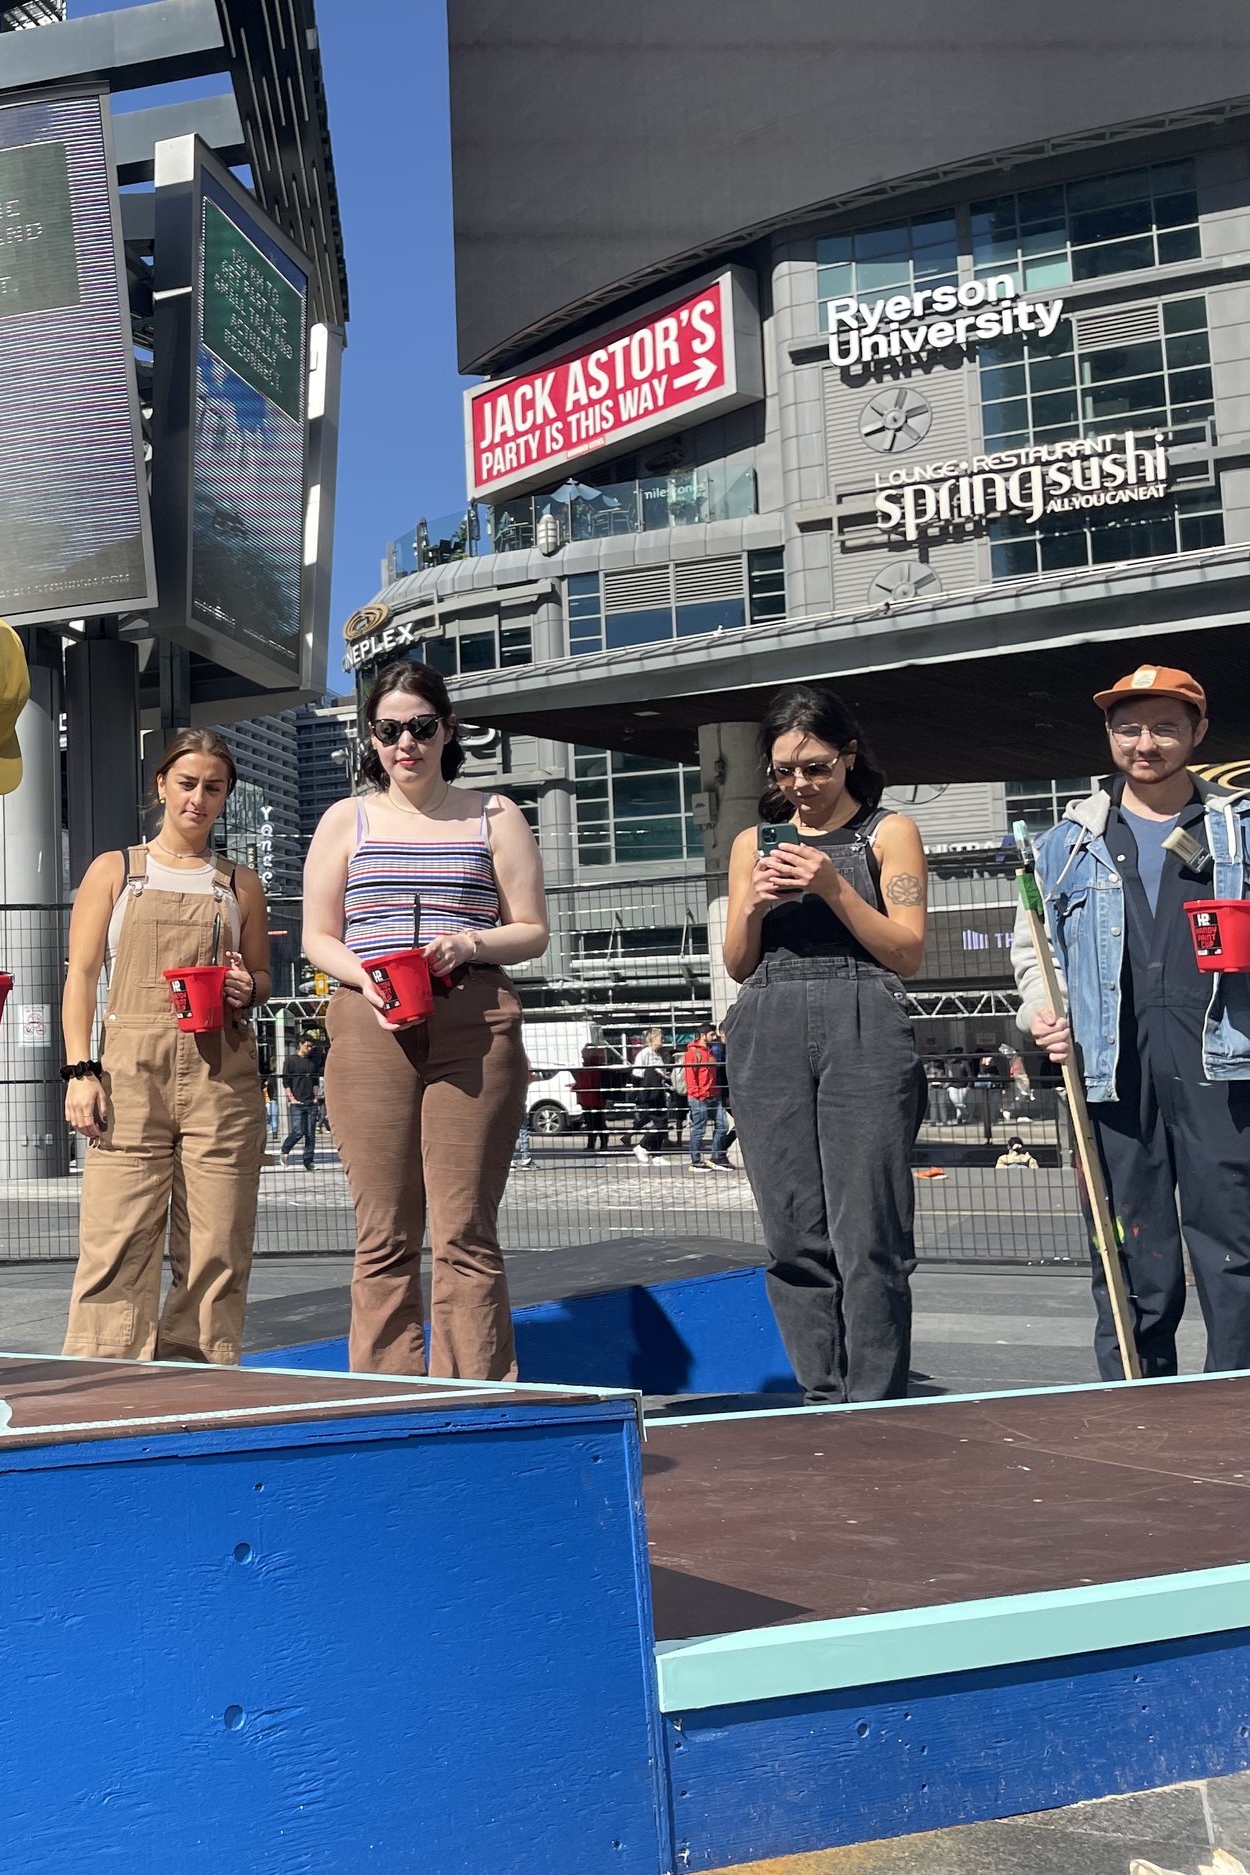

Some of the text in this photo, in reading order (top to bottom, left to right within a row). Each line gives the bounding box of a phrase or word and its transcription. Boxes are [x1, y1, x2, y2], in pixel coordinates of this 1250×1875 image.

[827, 273, 1015, 336] Ryerson
[829, 299, 1064, 367] University
[480, 299, 717, 449] JACK ASTOR'S
[481, 374, 669, 481] PARTY IS THIS WAY
[875, 433, 1116, 488] LOUNGE RESTAURANT
[875, 431, 1167, 541] spring sushi
[261, 805, 274, 883] Yonge
